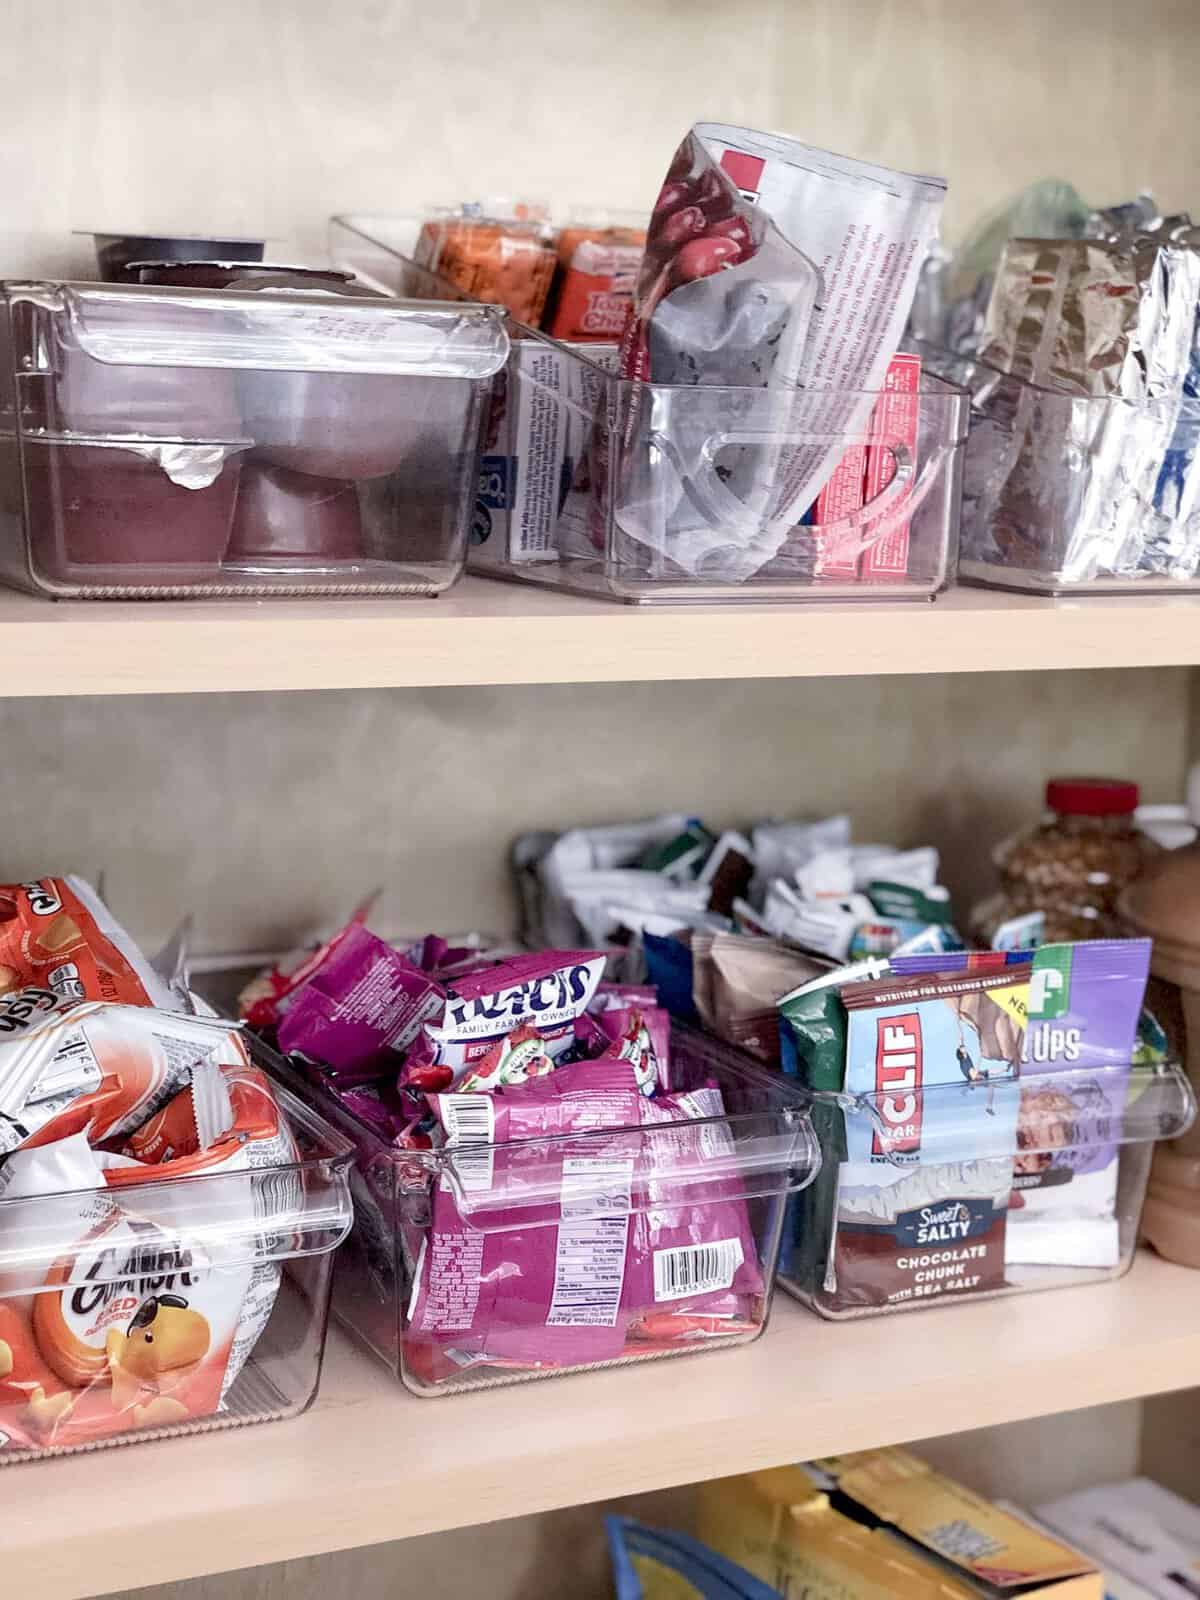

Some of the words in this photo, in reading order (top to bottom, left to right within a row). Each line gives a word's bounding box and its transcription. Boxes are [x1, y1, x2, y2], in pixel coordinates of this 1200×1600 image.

[875, 989, 919, 1003] NUTRITION
[920, 986, 936, 996] FOR
[456, 1024, 490, 1034] FAMILY
[1034, 1023, 1081, 1062] UPS
[883, 1026, 916, 1122] CLIF
[919, 1203, 961, 1227] Sweet
[916, 1222, 970, 1243] SALTY
[896, 1245, 987, 1269] CHOCOLATE
[915, 1264, 965, 1282] CHUNK
[914, 1284, 942, 1297] SEA
[946, 1276, 981, 1290] SALT
